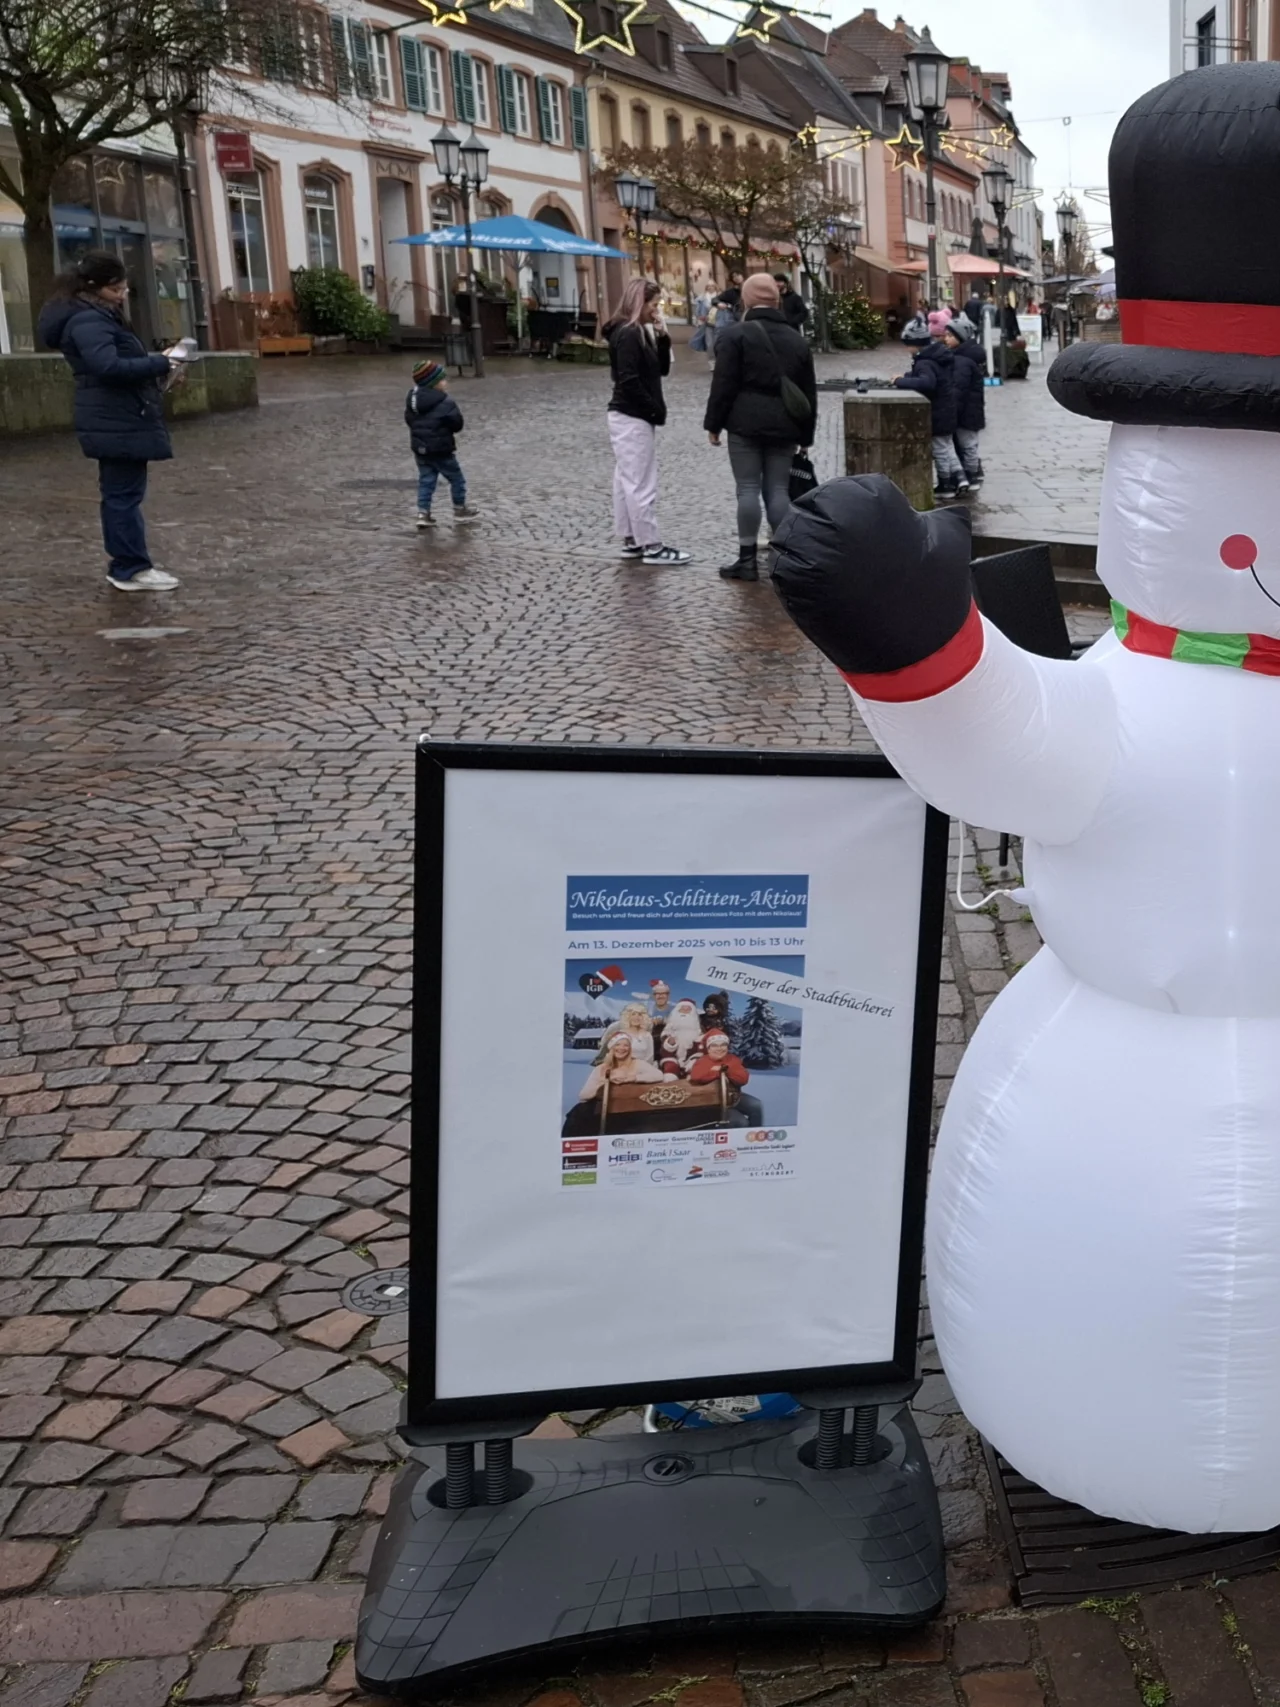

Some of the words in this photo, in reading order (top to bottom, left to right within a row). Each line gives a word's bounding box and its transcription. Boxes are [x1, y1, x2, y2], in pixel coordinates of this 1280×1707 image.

[569, 888, 807, 911] Nikolaus-Schlitten-Aktion
[568, 940, 589, 949] Am
[593, 940, 608, 949] 13.
[612, 939, 675, 949] Dezember
[677, 939, 706, 948] 2025
[734, 938, 746, 946] 10
[750, 937, 766, 946] bis
[784, 937, 804, 946] Uhr
[707, 965, 728, 981] Im
[733, 971, 774, 992] Foyer
[776, 980, 800, 996] der
[802, 986, 895, 1018] Stadtbücherei
[646, 1149, 667, 1158] Bank
